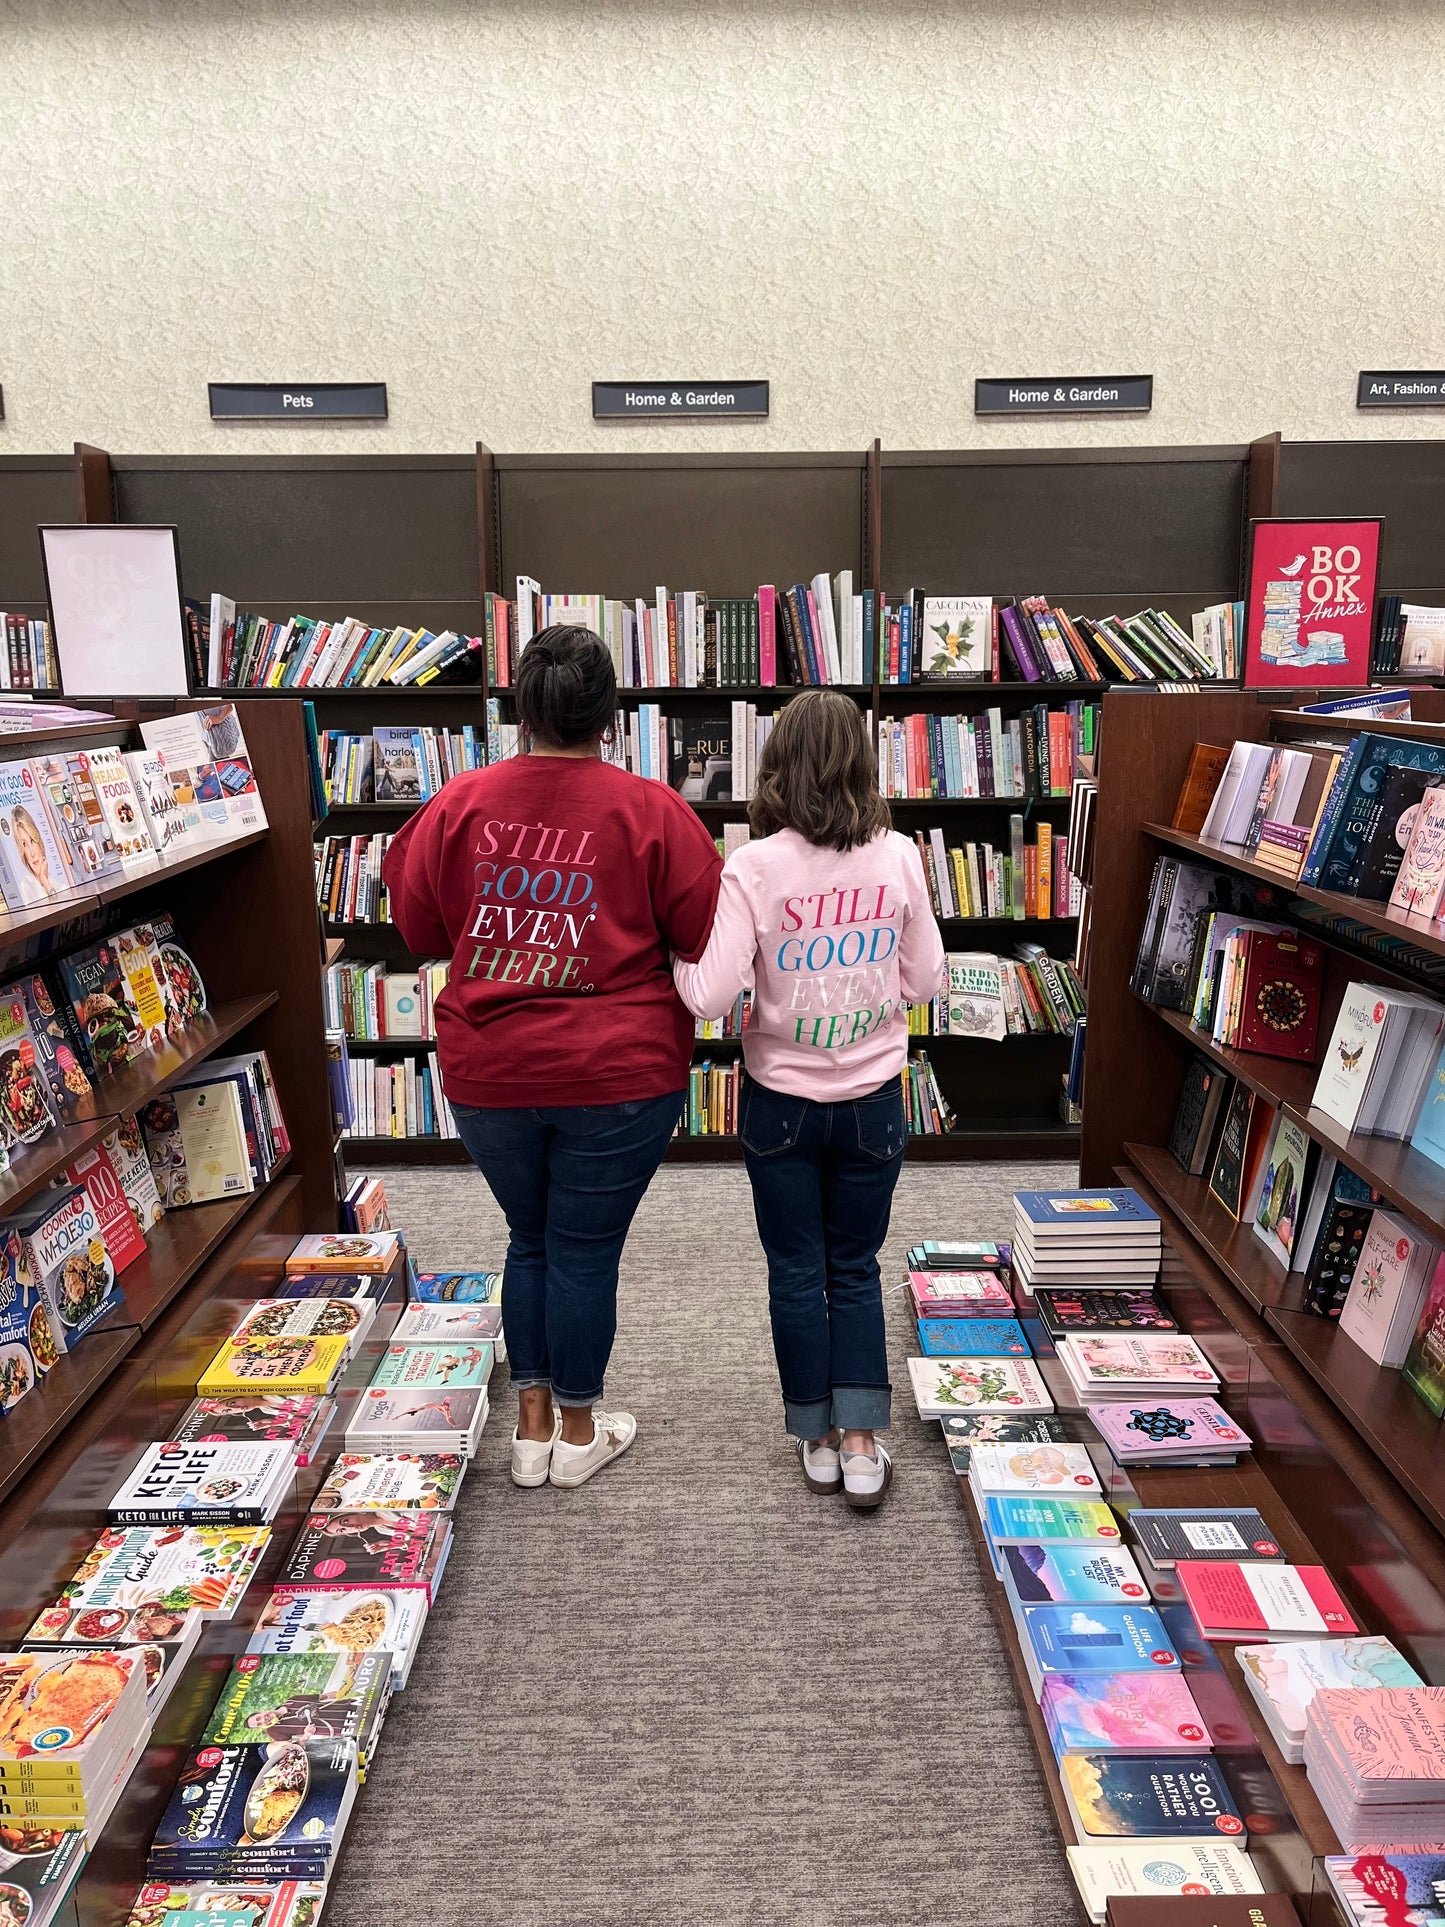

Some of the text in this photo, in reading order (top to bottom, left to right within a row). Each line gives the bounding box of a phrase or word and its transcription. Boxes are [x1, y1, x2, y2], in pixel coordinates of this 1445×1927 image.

[282, 394, 314, 409] Pets
[624, 391, 735, 406] Home & Garden
[1008, 387, 1119, 404] Home & Garden
[1369, 382, 1437, 397] Art, Fashion
[1311, 546, 1361, 575] BO
[1307, 575, 1360, 604] OK
[1302, 600, 1368, 624] Annex
[486, 618, 497, 672] JUNGALOW
[697, 740, 729, 755] RUE
[975, 729, 983, 759] TULIPS
[984, 729, 992, 759] TULIPS
[1026, 717, 1035, 774] PLANTOPEDIA
[142, 760, 164, 775] BIRDS
[1041, 736, 1050, 786] LIVING WILD
[102, 781, 131, 799] FOODS
[134, 780, 146, 802] BIRDS
[1425, 815, 1434, 826] 101
[1432, 831, 1442, 839] SAY
[474, 820, 598, 866] STILL
[1039, 827, 1051, 874] FLOWER
[474, 861, 598, 914] GOOD,
[780, 884, 896, 933] STILL
[467, 903, 596, 950] EVEN
[124, 950, 148, 975] 500
[777, 927, 897, 972] GOOD,
[74, 961, 106, 986] VEGAN
[950, 967, 1000, 981] GARDEN
[951, 975, 1000, 990] WISDOM
[1039, 956, 1066, 1005] GARDEN
[959, 984, 1000, 996] KNOW-HOW
[1347, 1005, 1374, 1030] MINDFUL
[1353, 1022, 1364, 1033] YEAR
[132, 1161, 147, 1177] KETO
[41, 1206, 73, 1241] COOKIN
[39, 1211, 95, 1266] WHOLE30
[1366, 1236, 1400, 1272] SELF-CARE
[24, 1240, 53, 1316] COOKING WHOLE30
[77, 1300, 110, 1332] MELISSA URBAN
[236, 1355, 258, 1378] WHAT
[249, 1367, 263, 1377] TO
[262, 1364, 279, 1377] EAT
[275, 1356, 295, 1377] WHEN
[288, 1338, 318, 1377] COOKBOOK
[403, 1350, 425, 1382] STRENGTH
[415, 1352, 436, 1381] TRAINING
[1012, 1360, 1042, 1406] BOTANICAL ARTIST
[368, 1401, 389, 1422] Yoga
[133, 1449, 189, 1498] KETO
[175, 1449, 218, 1486] LIFE
[246, 1453, 275, 1497] MARK SISSON
[166, 1485, 189, 1498] FOR
[361, 1466, 383, 1499] Vitamins
[372, 1467, 397, 1499] Minerals
[385, 1480, 403, 1499] Bible
[117, 1511, 147, 1521] KETO
[148, 1513, 160, 1521] FOR
[161, 1511, 185, 1521] LIFE
[413, 1512, 434, 1535] OUT
[1198, 1525, 1216, 1547] POWER
[1208, 1527, 1224, 1545] WORD
[1221, 1523, 1242, 1549] IMPROVE
[86, 1529, 154, 1607] ANTI-INFLAMMATORY
[124, 1549, 159, 1582] Guide
[290, 1531, 324, 1580] DAPHNE
[379, 1551, 397, 1575] EAT
[1082, 1565, 1096, 1580] LIST
[1090, 1559, 1108, 1586] BUCKET
[1099, 1556, 1121, 1589] ULTIMATE
[1113, 1566, 1127, 1579] MY
[284, 1596, 311, 1639] for food
[1122, 1614, 1148, 1659] QUESTIONS
[1138, 1628, 1153, 1644] LIFE
[350, 1657, 376, 1708] MAURO
[213, 1709, 238, 1744] Come
[228, 1691, 244, 1708] On
[1124, 1694, 1148, 1730] BURN
[1388, 1711, 1433, 1755] Journal
[187, 1746, 240, 1844] comfort
[1150, 1774, 1173, 1818] QUESTIONS
[1162, 1773, 1188, 1817] RATHER
[1177, 1773, 1201, 1818] WOULD YOU
[1190, 1772, 1222, 1817] 3001
[177, 1806, 207, 1839] Simply
[242, 1846, 298, 1857] comfort
[236, 1863, 291, 1873] comfort
[1212, 1847, 1246, 1894] Emotiona
[153, 1887, 168, 1901] $10
